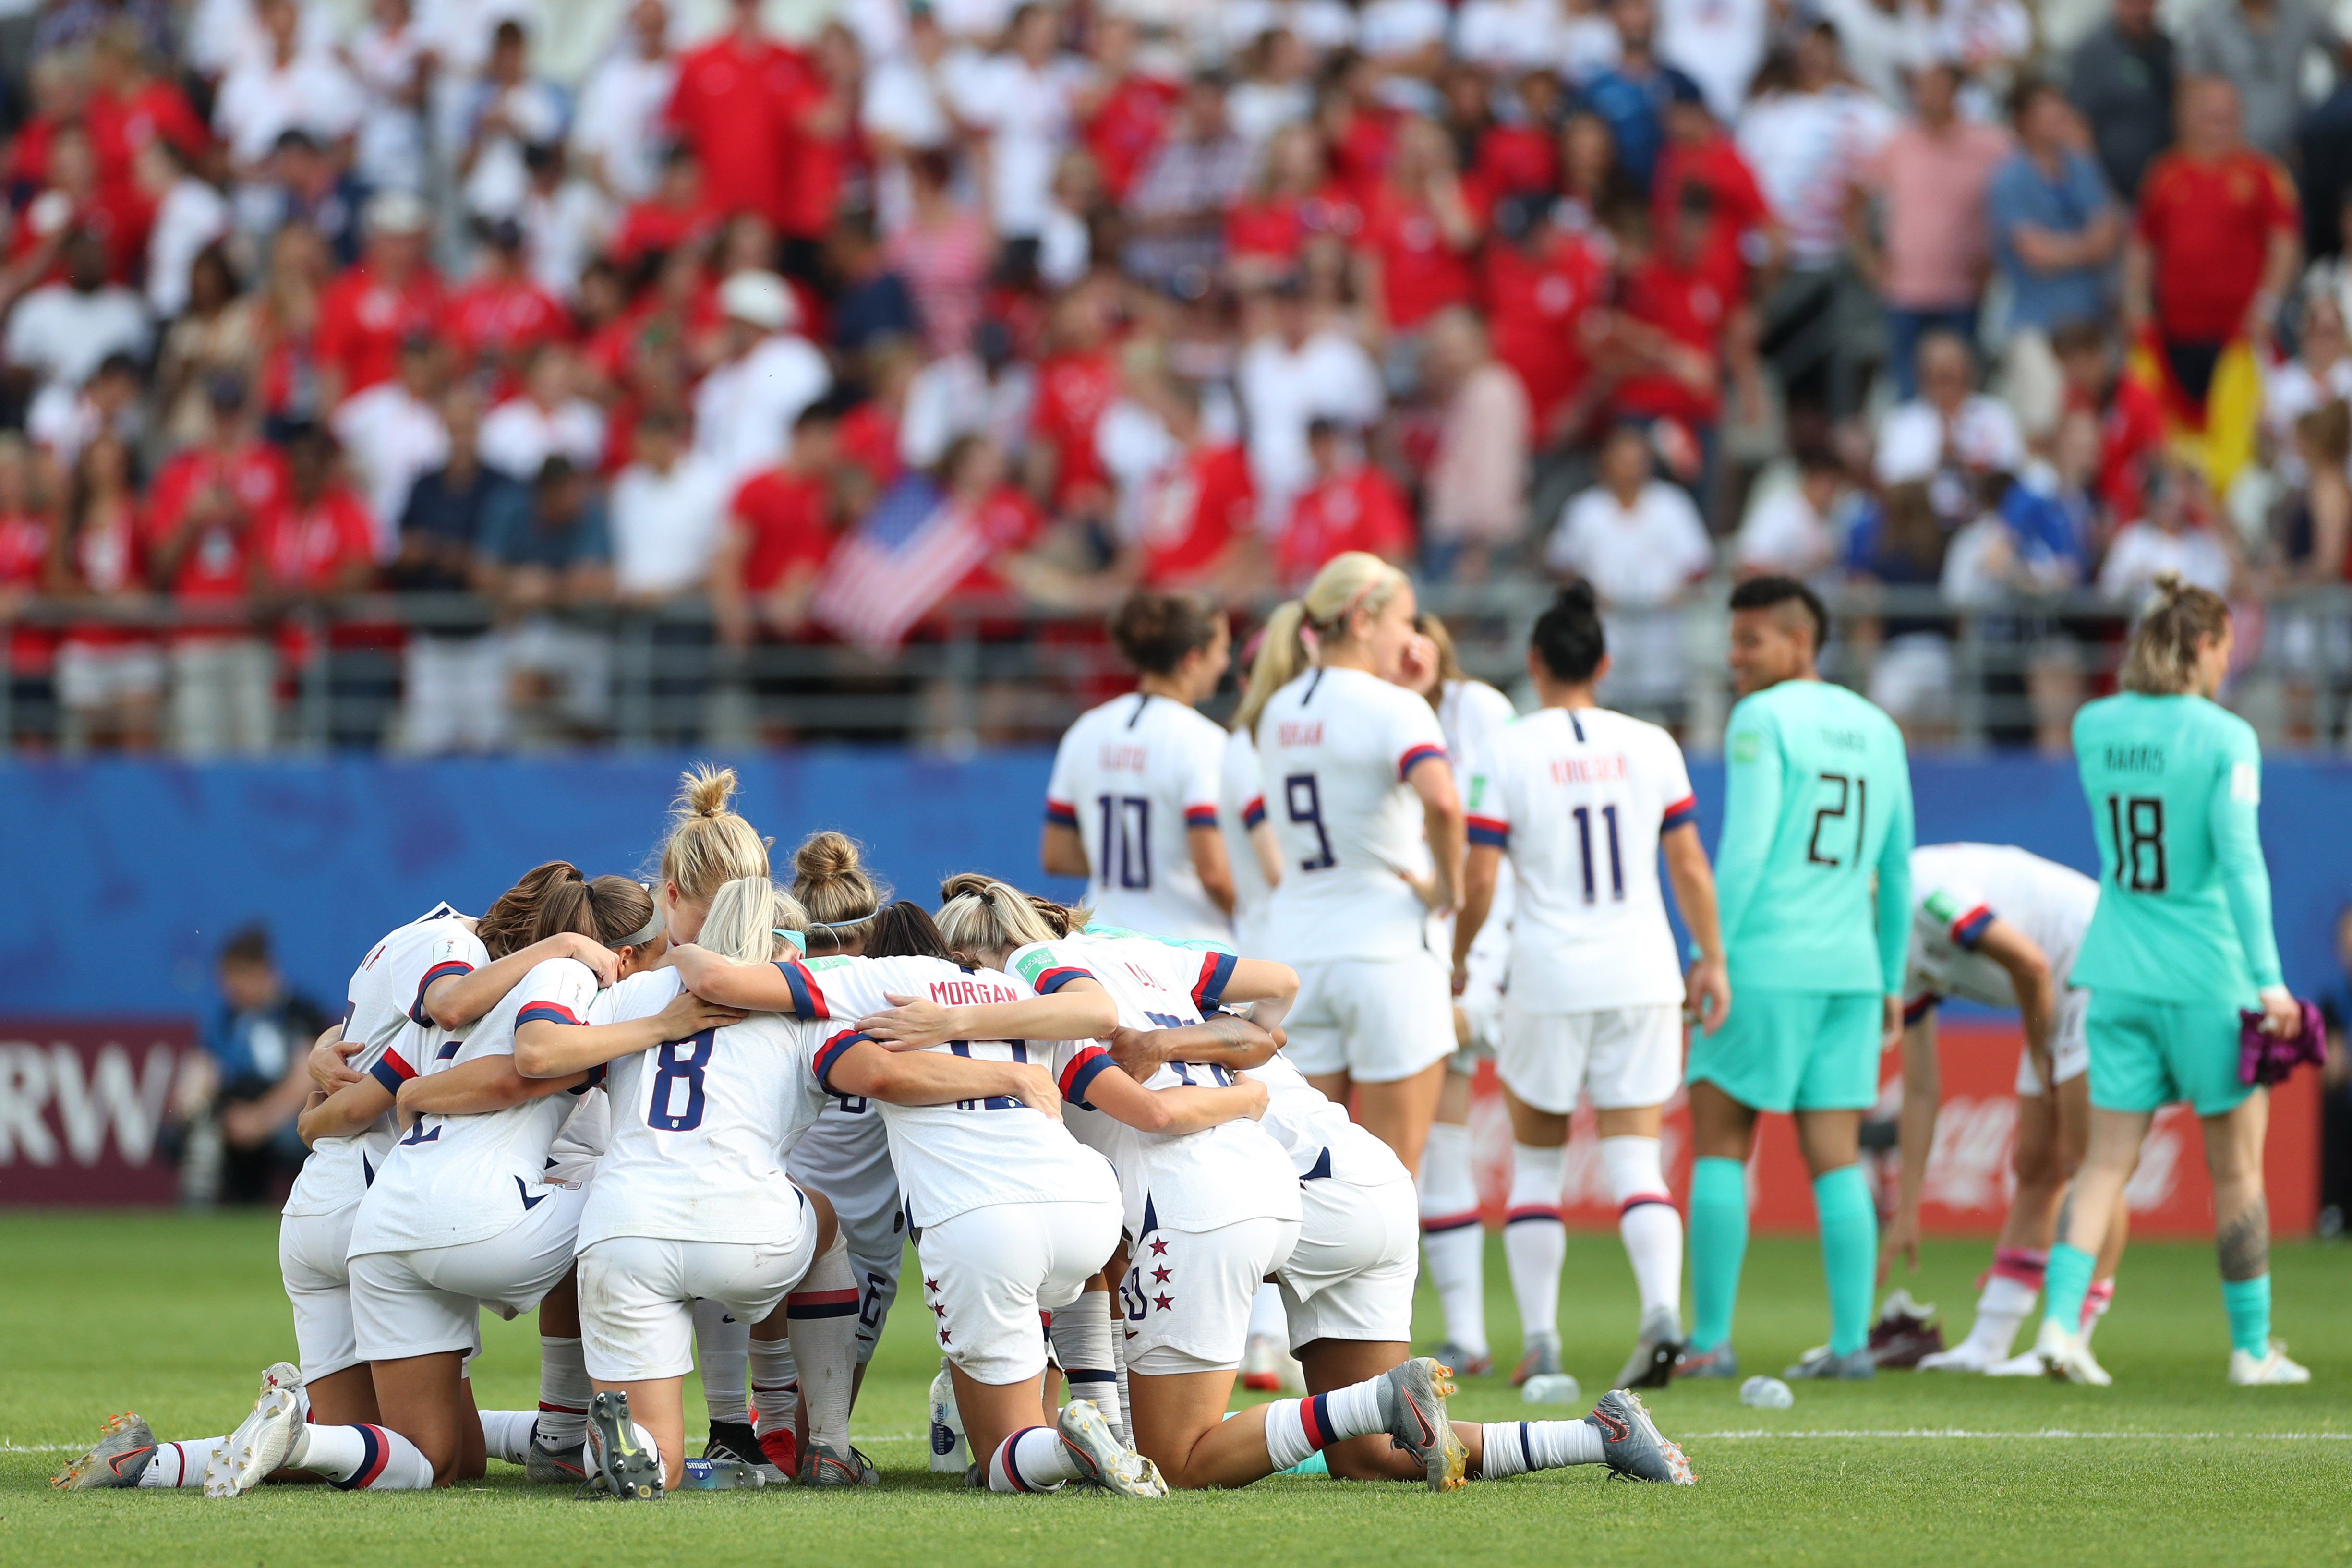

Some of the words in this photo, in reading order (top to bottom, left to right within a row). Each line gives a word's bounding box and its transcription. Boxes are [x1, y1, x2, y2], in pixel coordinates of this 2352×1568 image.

[1098, 795, 1150, 890] 10
[1286, 774, 1336, 871] 9
[1573, 806, 1623, 903] 11
[1807, 772, 1865, 871] 21
[2108, 796, 2165, 891] 18
[929, 981, 1018, 1005] MORGAN
[647, 1027, 716, 1132] 8
[685, 1461, 730, 1470] smartwater
[935, 1402, 945, 1455] smartwater
